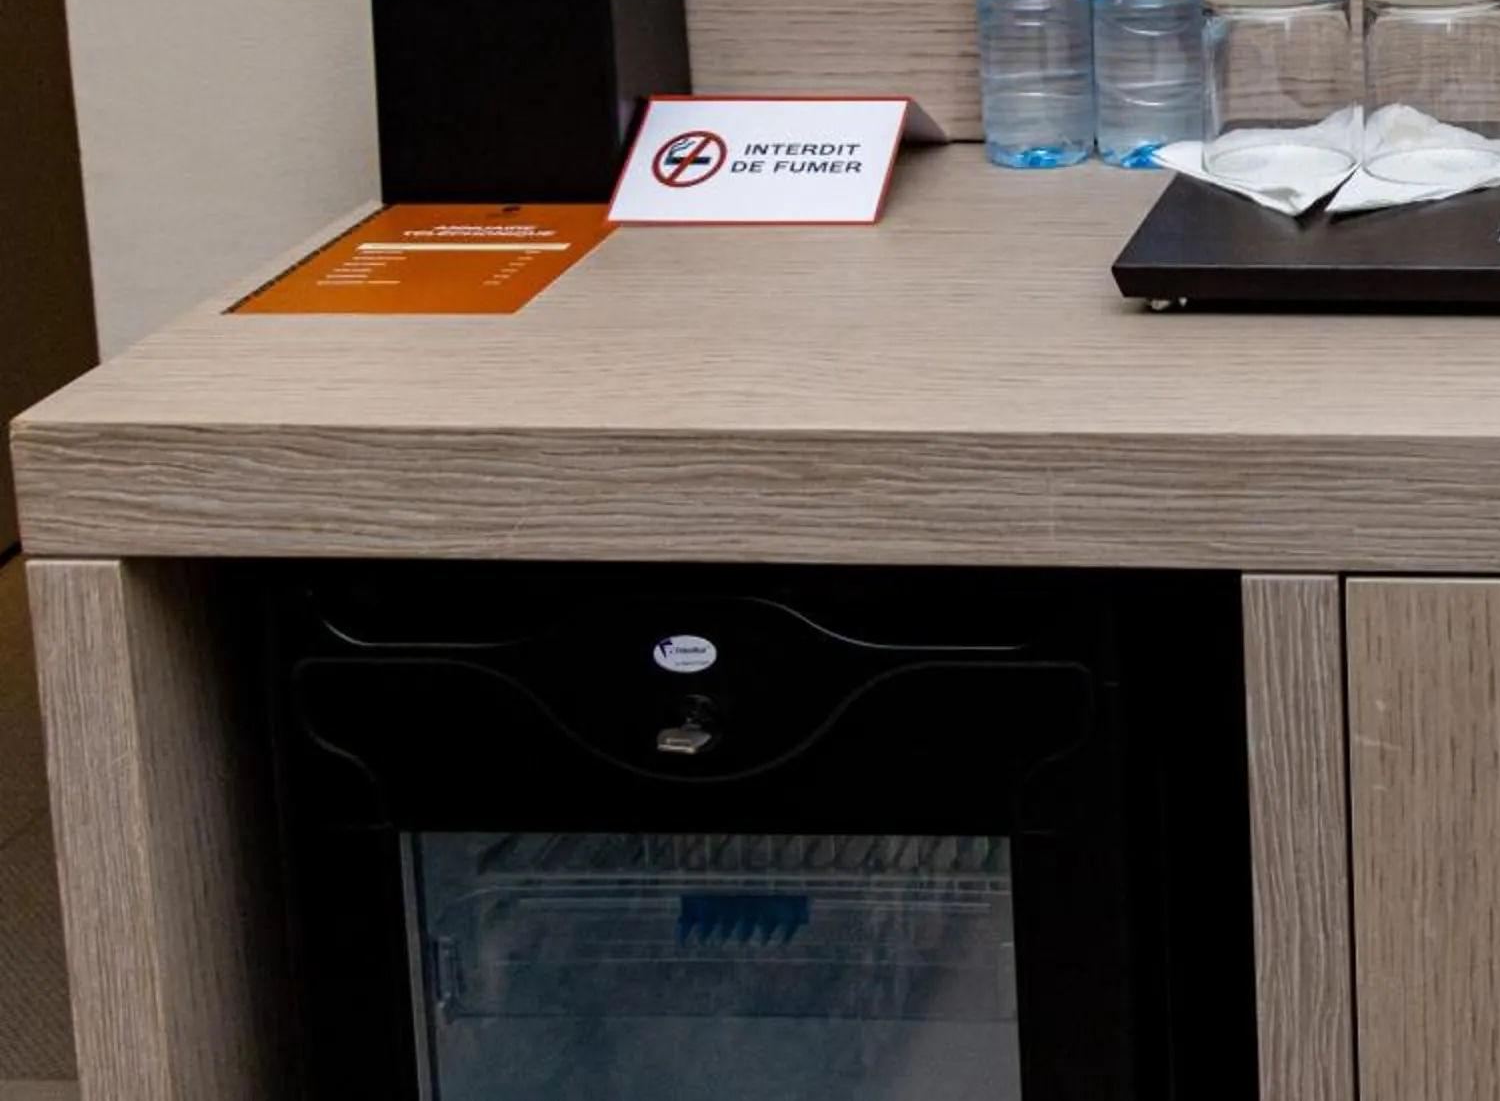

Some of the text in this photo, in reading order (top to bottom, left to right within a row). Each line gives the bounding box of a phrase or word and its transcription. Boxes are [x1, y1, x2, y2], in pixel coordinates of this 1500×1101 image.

[743, 143, 862, 156] INTERDIT
[730, 160, 863, 174] DE FUMER
